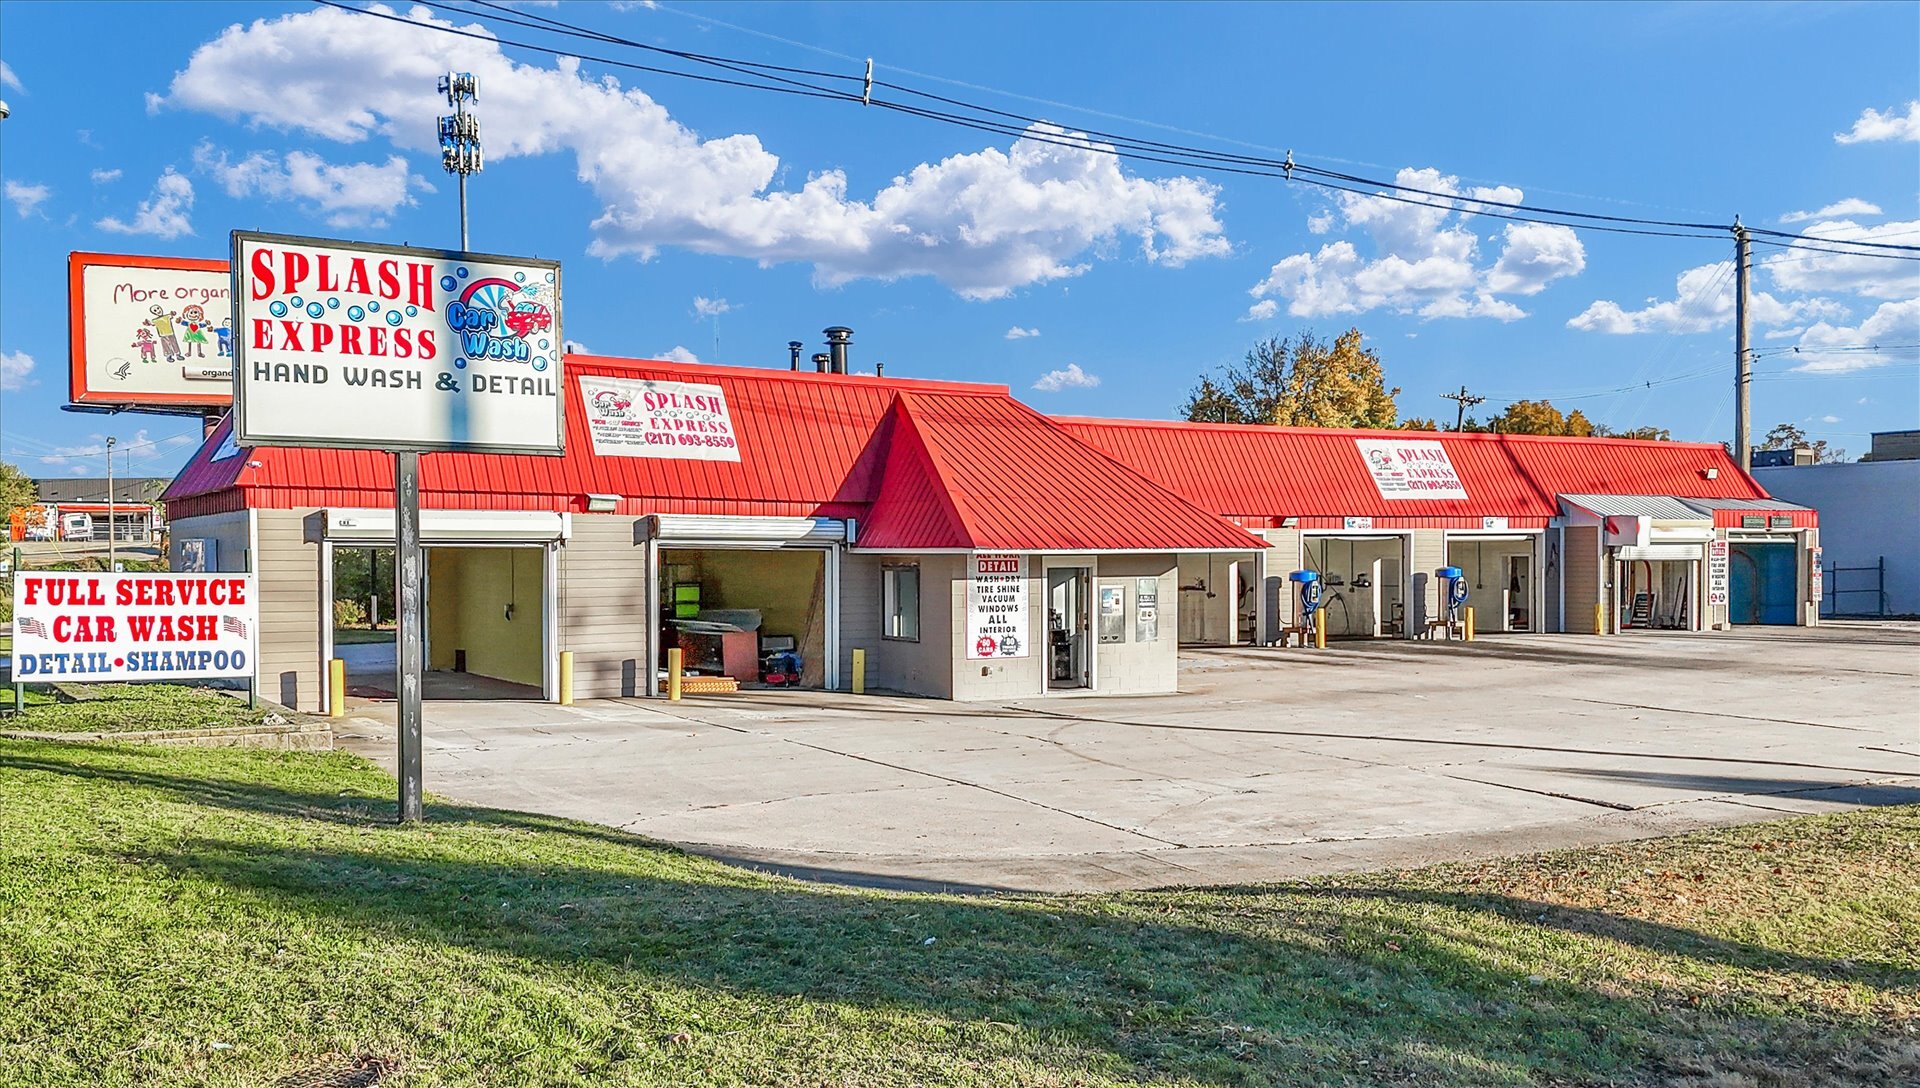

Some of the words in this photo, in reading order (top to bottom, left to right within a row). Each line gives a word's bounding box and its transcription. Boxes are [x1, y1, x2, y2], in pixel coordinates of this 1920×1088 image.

[251, 248, 435, 312] SPLASH
[114, 283, 169, 304] More
[174, 287, 230, 305] organ
[446, 301, 498, 333] Car
[252, 318, 437, 360] EXPRESS
[460, 329, 531, 364] Wash
[253, 361, 328, 384] HAND
[343, 366, 422, 389] WASH
[435, 371, 461, 394] &
[472, 373, 556, 397] DETAIL
[643, 391, 723, 416] SPLASH
[650, 417, 728, 434] EXPRESS
[644, 432, 676, 446] (217)
[677, 433, 735, 449] 693-8559
[1396, 448, 1446, 464] SPLASH
[1406, 468, 1454, 478] EXPRESS
[979, 561, 1017, 572] DETAIL
[24, 578, 105, 606] FULL
[116, 579, 246, 606] SERVICE
[976, 585, 993, 594] TIRE
[997, 585, 1020, 593] SHINE
[982, 594, 1016, 603] VACUUM
[978, 604, 1019, 613] WINDOWS
[52, 615, 117, 643] CAR
[127, 615, 218, 642] WASH
[988, 615, 1007, 624] ALL
[979, 626, 1017, 634] INTERIOR
[19, 653, 112, 675] DETAIL
[126, 650, 246, 672] SHAMPOO
